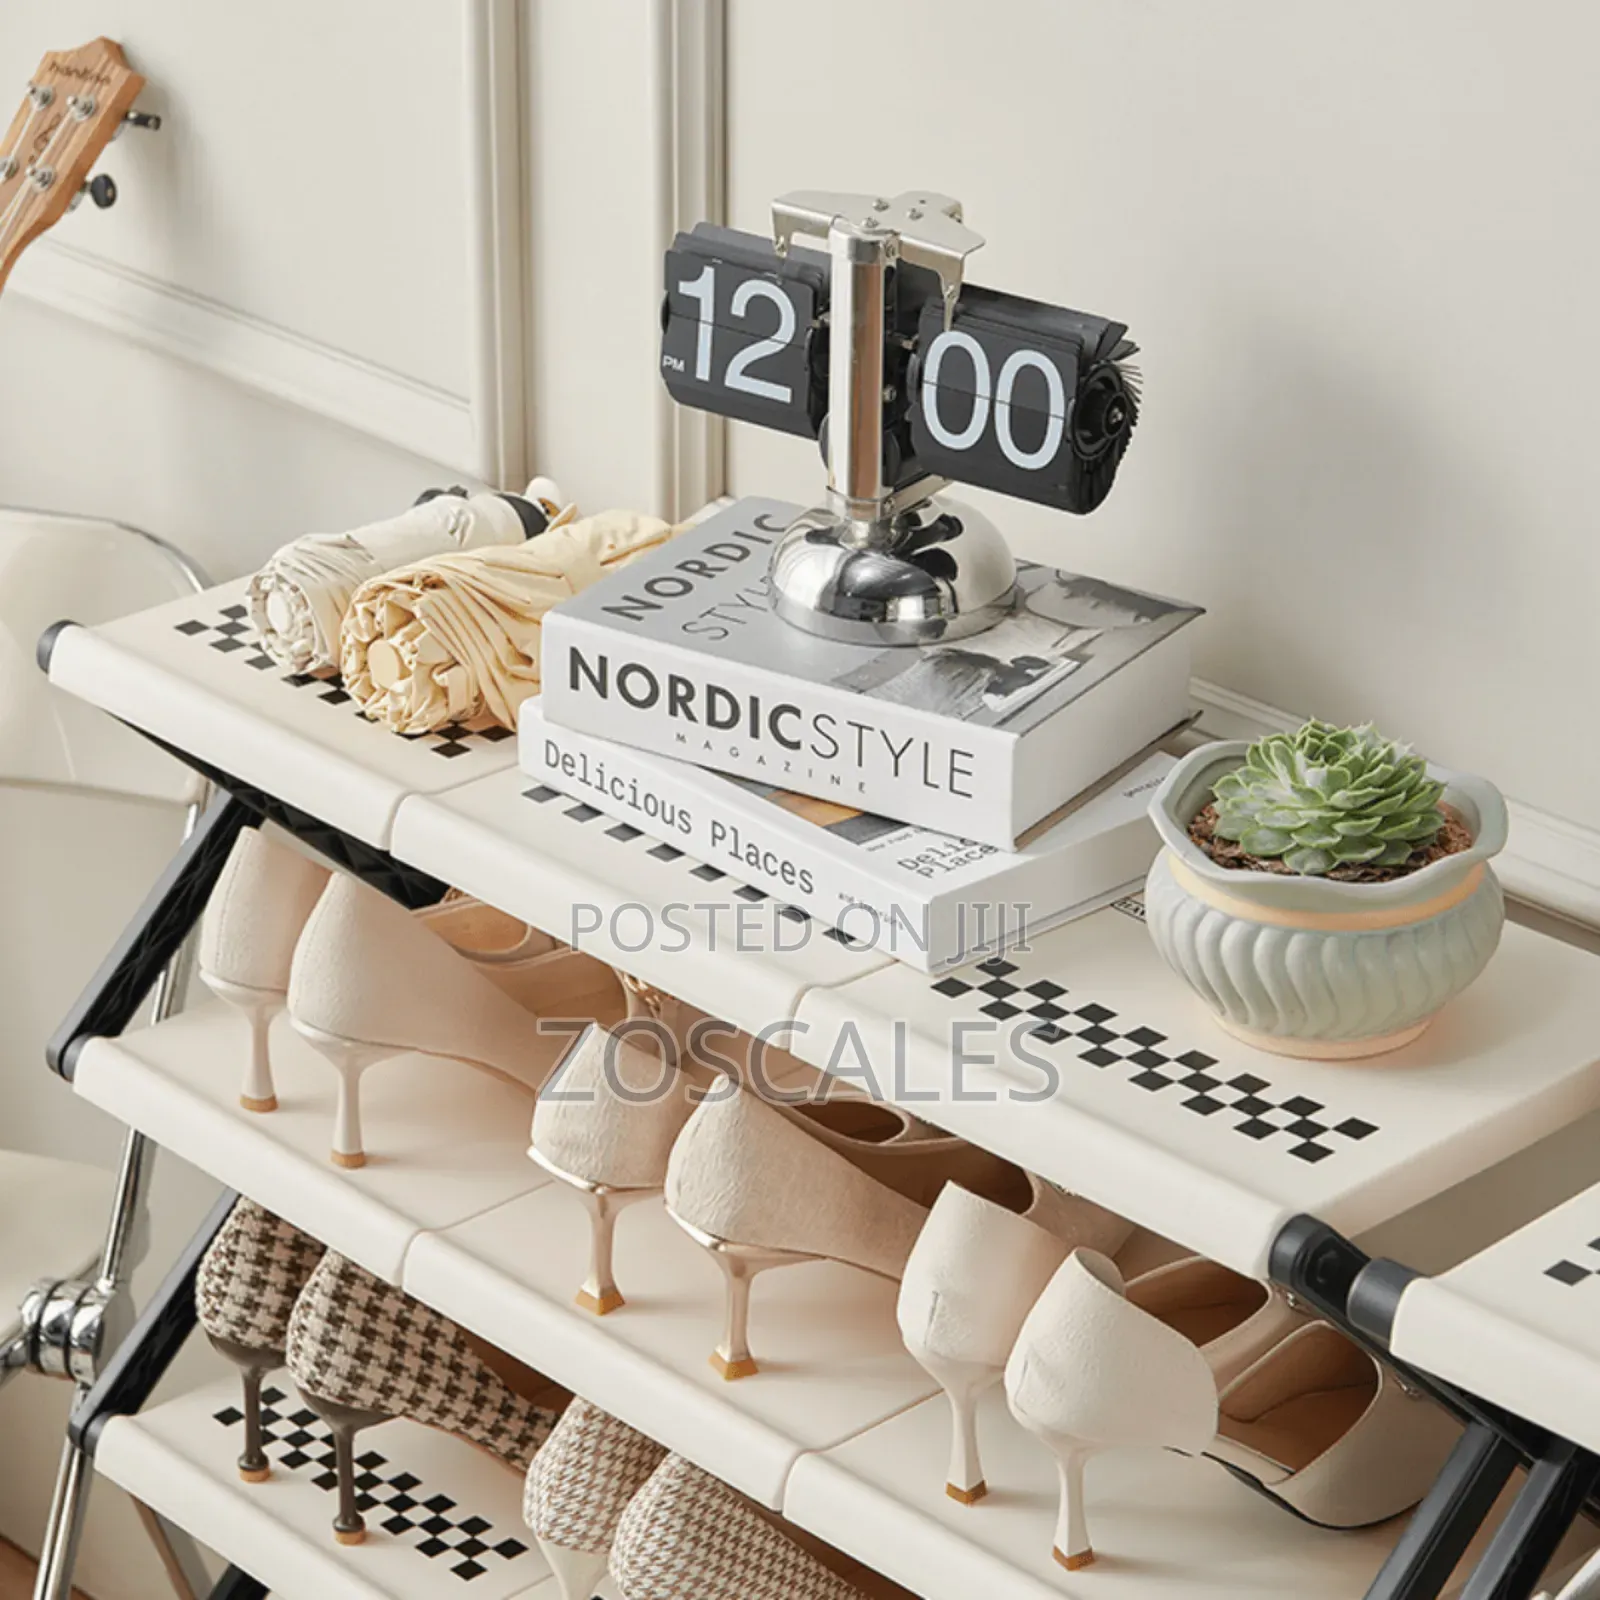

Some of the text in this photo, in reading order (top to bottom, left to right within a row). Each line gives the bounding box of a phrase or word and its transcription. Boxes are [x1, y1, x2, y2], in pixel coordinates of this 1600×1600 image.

[662, 354, 685, 373] PM
[678, 265, 796, 404] 12
[922, 330, 1065, 471] 00
[600, 513, 786, 622] NORDIC
[681, 575, 771, 641] STYL
[544, 739, 814, 895] Delicious Places
[675, 732, 867, 794] MAGAZINE
